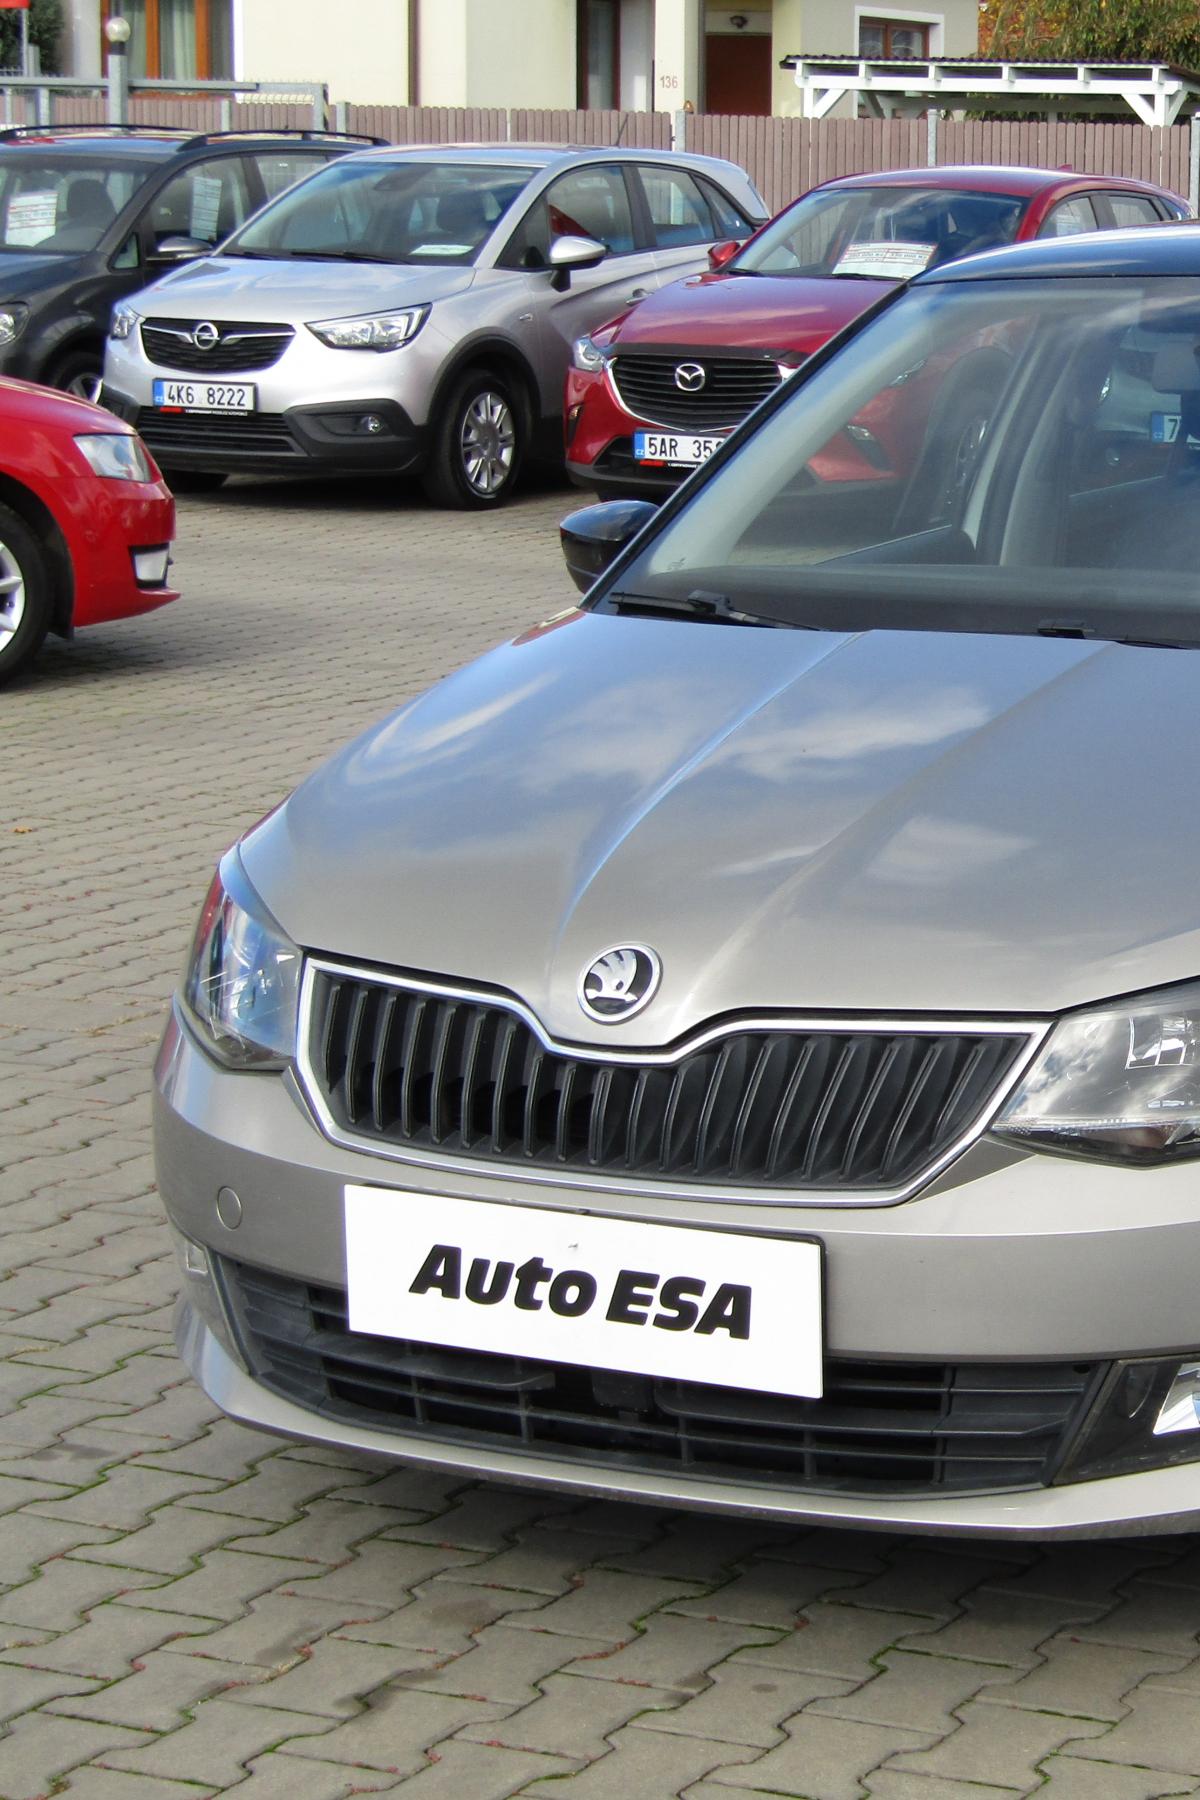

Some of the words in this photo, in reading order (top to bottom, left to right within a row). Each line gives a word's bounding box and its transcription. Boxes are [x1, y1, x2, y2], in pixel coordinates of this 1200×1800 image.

[660, 75, 678, 89] 136
[168, 385, 194, 404] 4K6
[207, 387, 246, 407] 8222
[648, 437, 678, 457] 5AR
[408, 1244, 598, 1317] Auto
[605, 1269, 752, 1340] ESA
